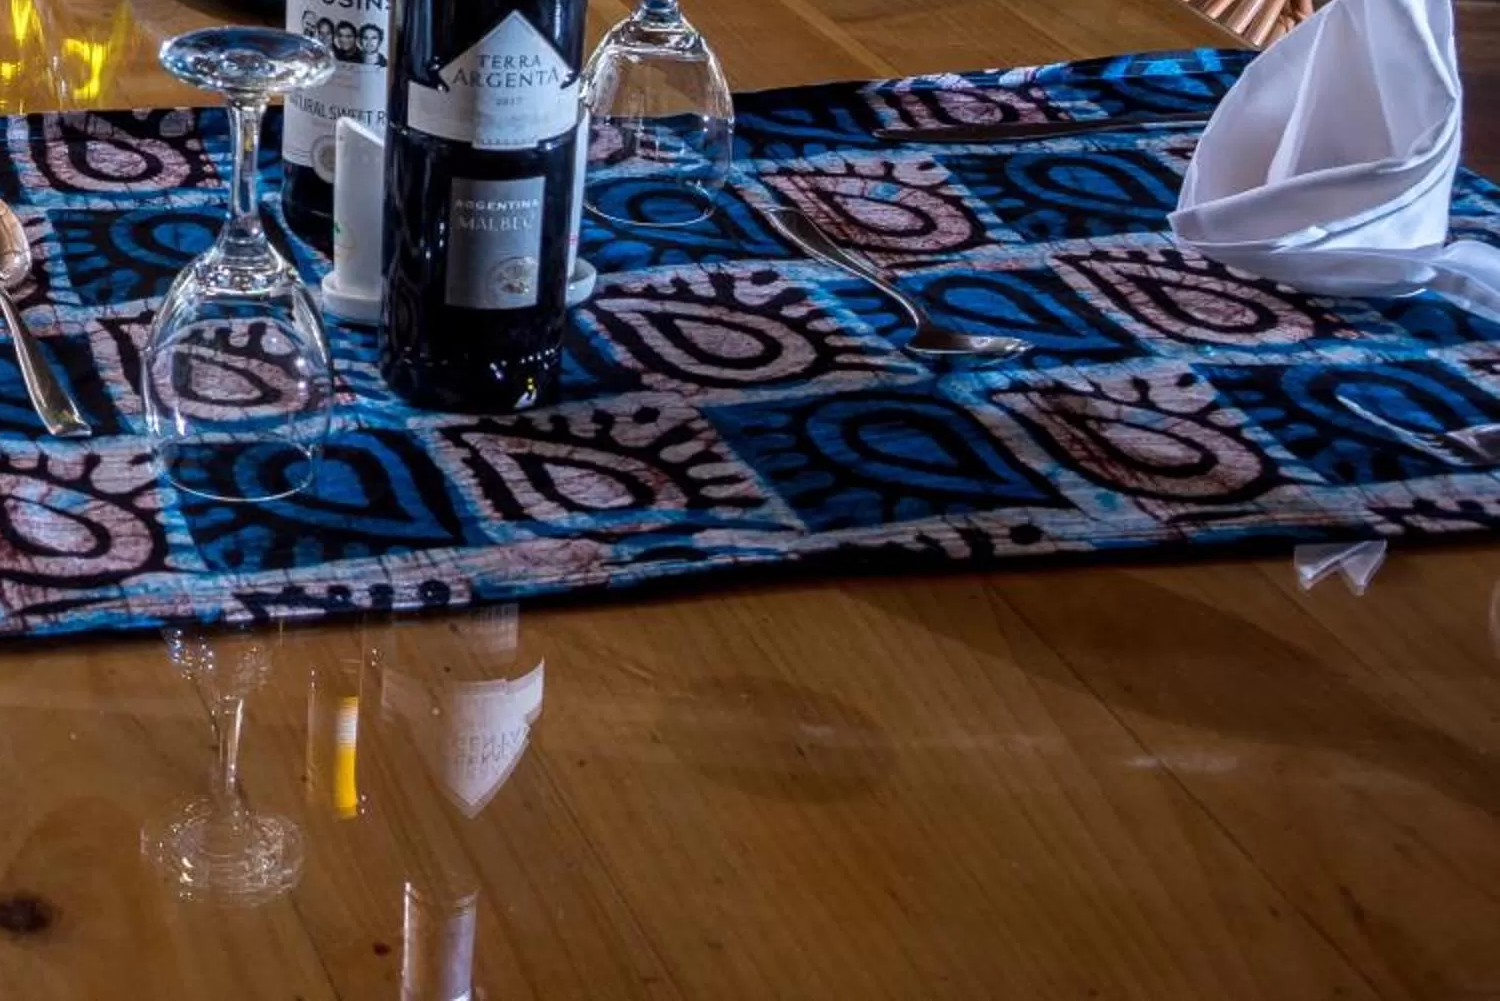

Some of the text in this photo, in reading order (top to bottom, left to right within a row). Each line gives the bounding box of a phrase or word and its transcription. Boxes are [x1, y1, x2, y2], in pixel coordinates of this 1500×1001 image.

[476, 54, 541, 69] TERRA
[453, 68, 559, 88] ARGENTA
[455, 200, 539, 211] ARGENTINA
